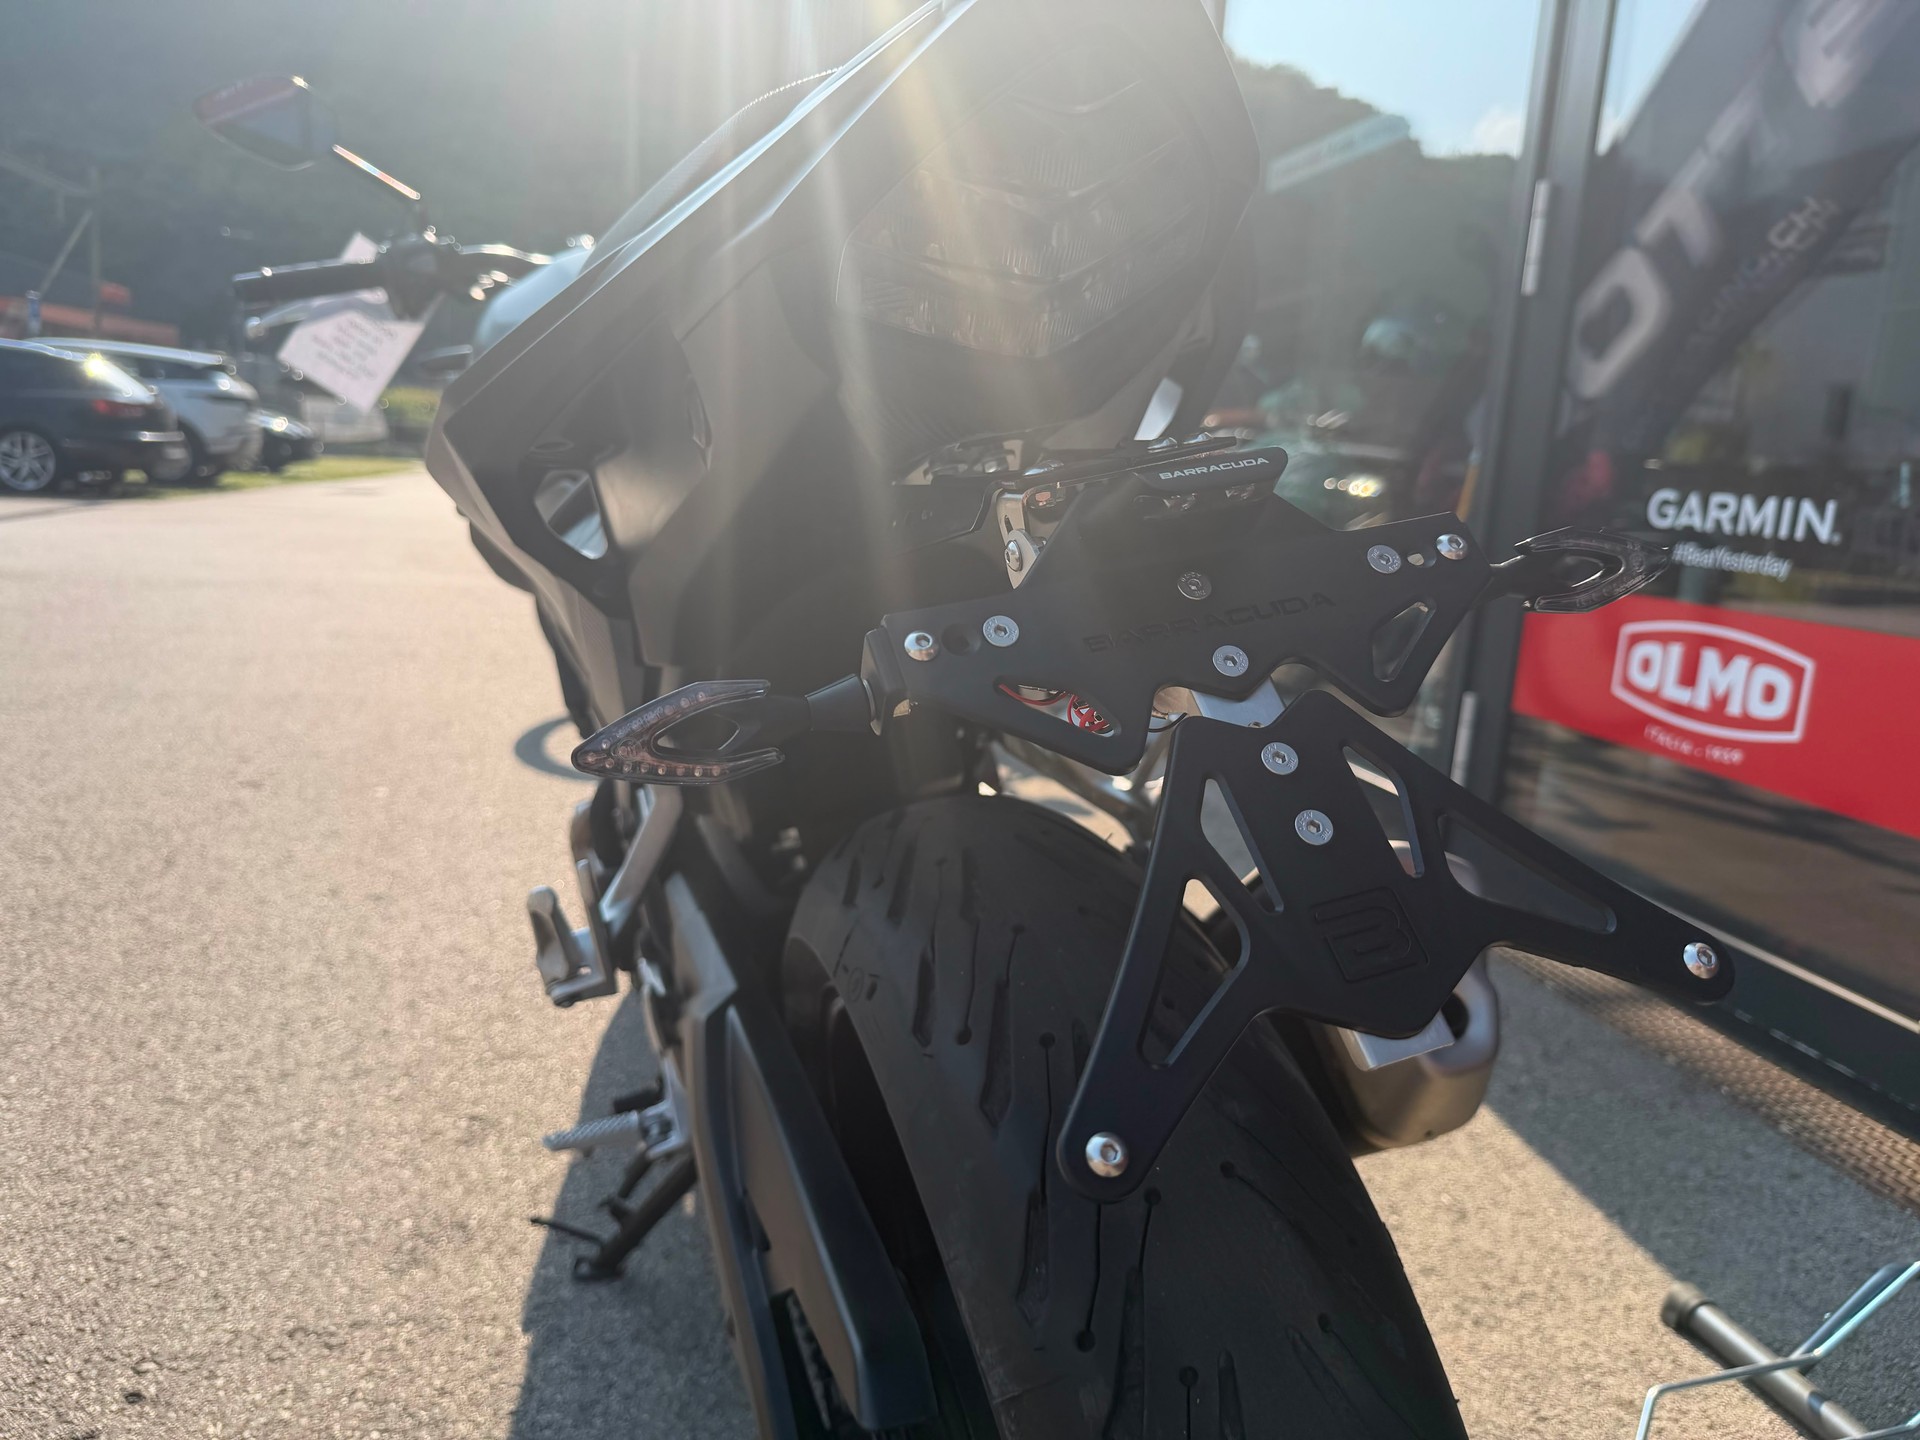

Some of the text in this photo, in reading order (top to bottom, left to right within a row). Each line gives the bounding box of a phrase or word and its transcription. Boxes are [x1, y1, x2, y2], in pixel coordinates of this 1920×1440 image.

[1158, 456, 1270, 481] BARRACUDA
[1082, 590, 1337, 654] BARRACUDA
[1626, 640, 1793, 721] OLMO
